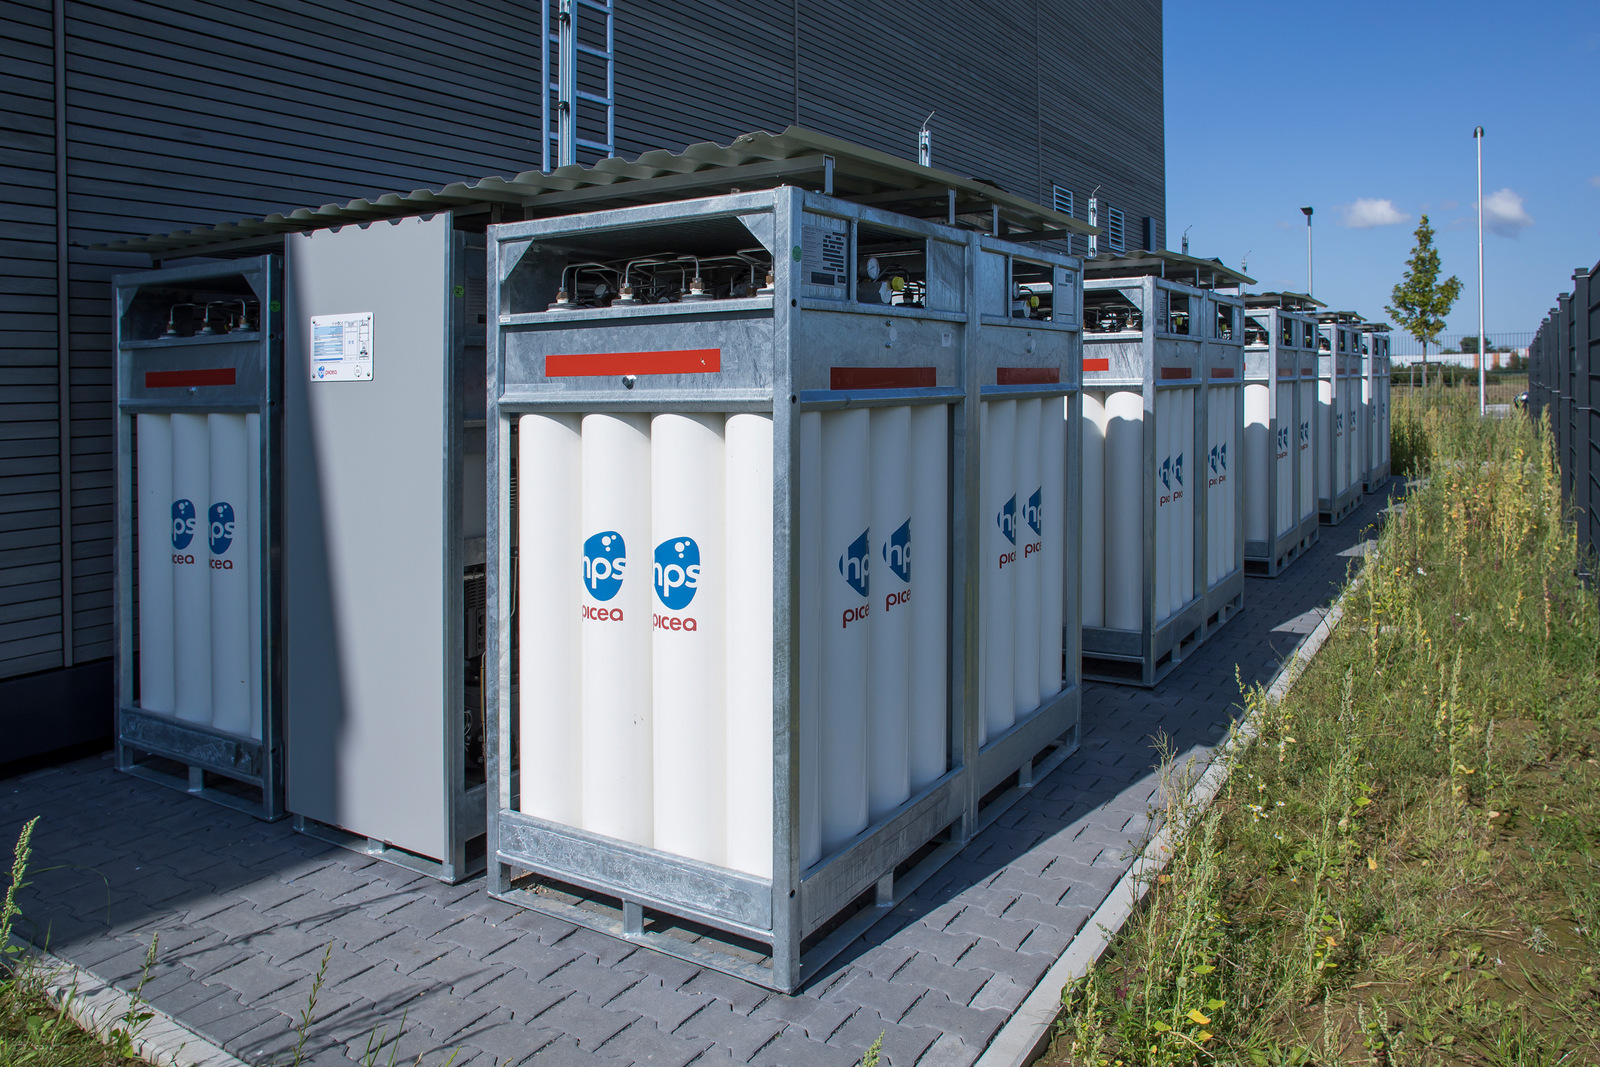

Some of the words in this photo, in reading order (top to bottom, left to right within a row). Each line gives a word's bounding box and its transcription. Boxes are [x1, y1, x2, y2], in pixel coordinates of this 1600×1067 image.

[172, 518, 196, 542] ps
[172, 554, 194, 564] cea
[582, 605, 624, 622] picea
[652, 613, 697, 631] picea
